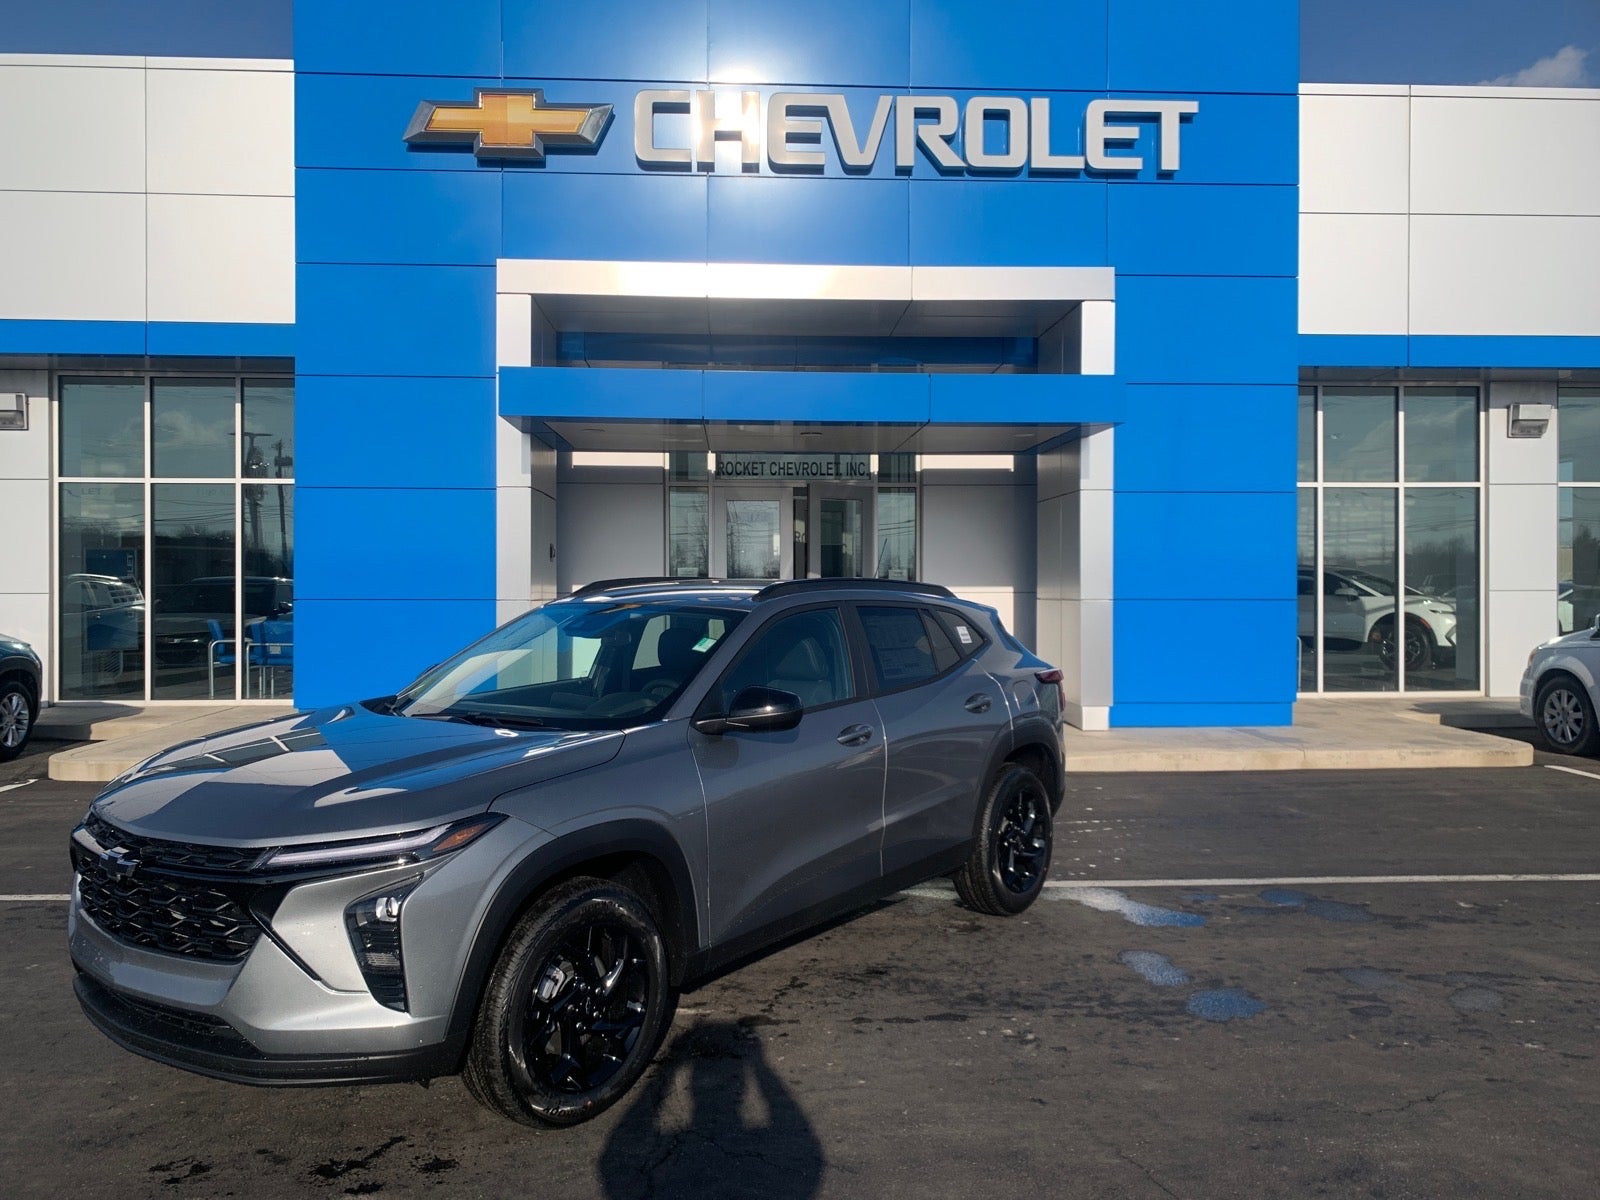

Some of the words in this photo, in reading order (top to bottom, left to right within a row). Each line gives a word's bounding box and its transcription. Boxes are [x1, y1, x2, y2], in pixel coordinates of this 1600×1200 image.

[633, 88, 1200, 175] CHEVROLET
[717, 461, 766, 476] ROCKET
[846, 461, 870, 477] INC.
